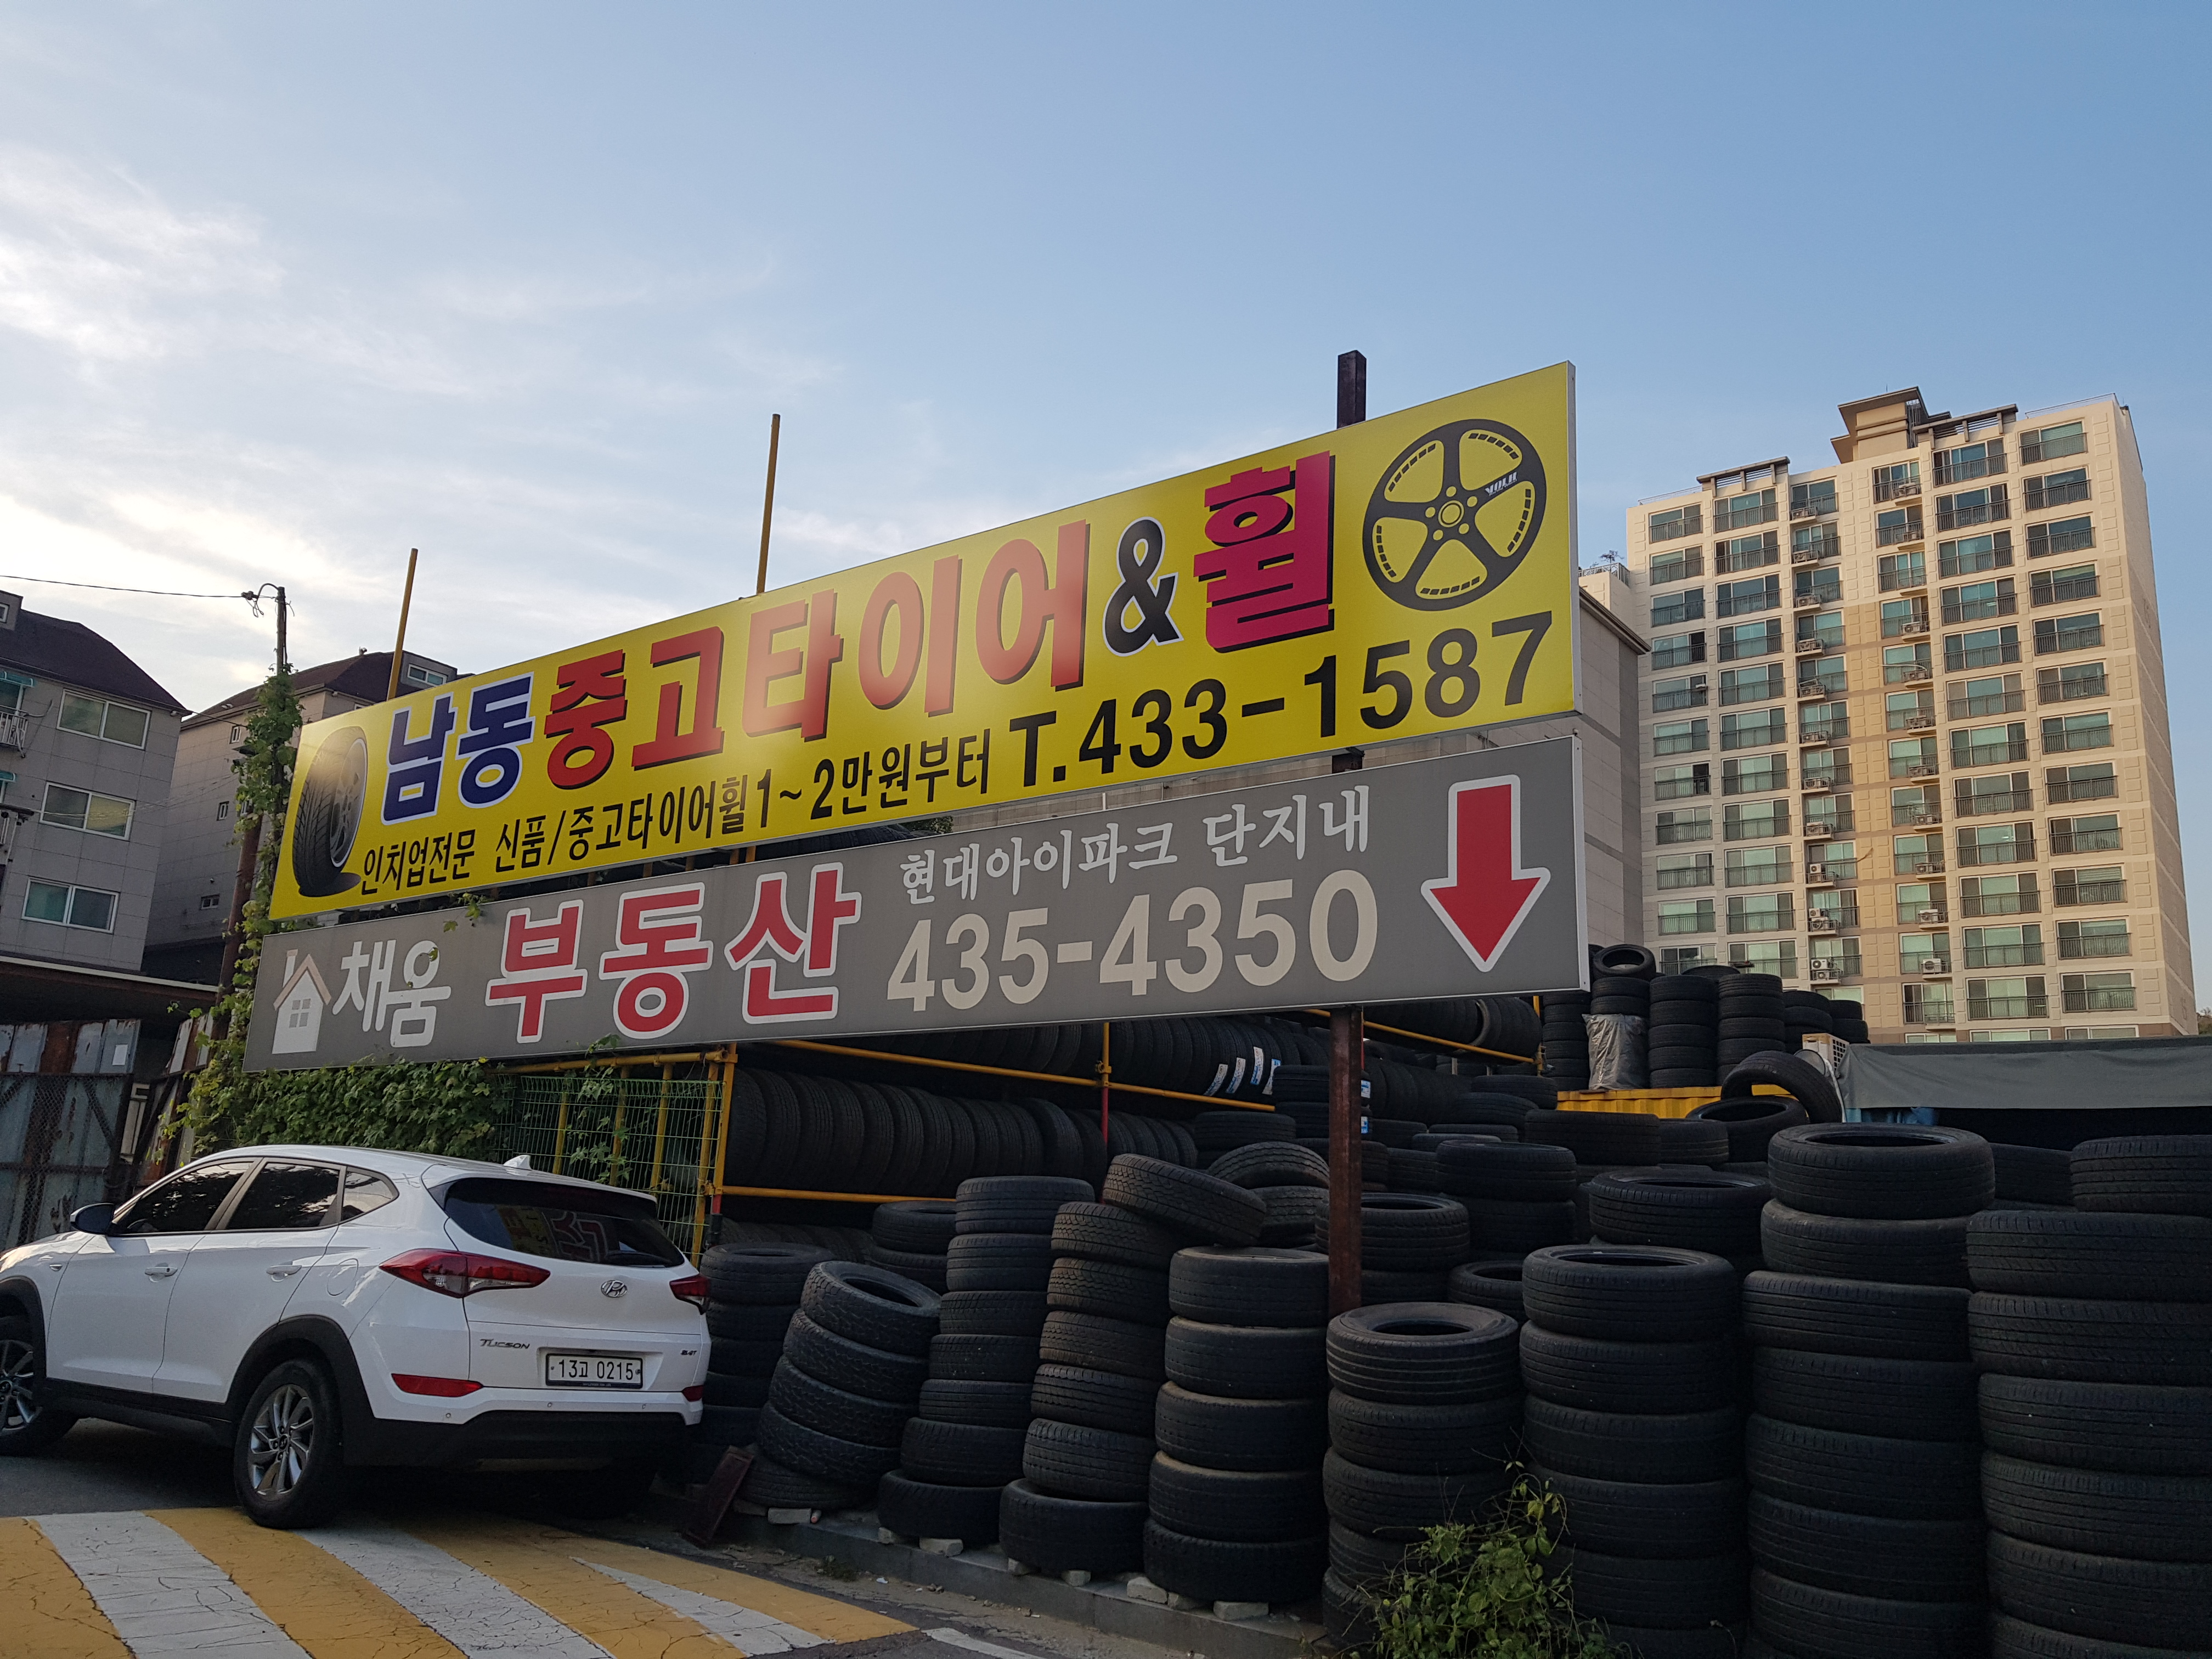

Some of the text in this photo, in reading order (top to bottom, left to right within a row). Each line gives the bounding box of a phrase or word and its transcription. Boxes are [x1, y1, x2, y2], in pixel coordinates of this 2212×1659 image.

[360, 828, 476, 895] 인치업전문
[900, 785, 1370, 905] 현대아이파크 단지내
[332, 862, 1378, 1048] 채움 부동산 435-4350
[597, 1361, 633, 1380] 0215
